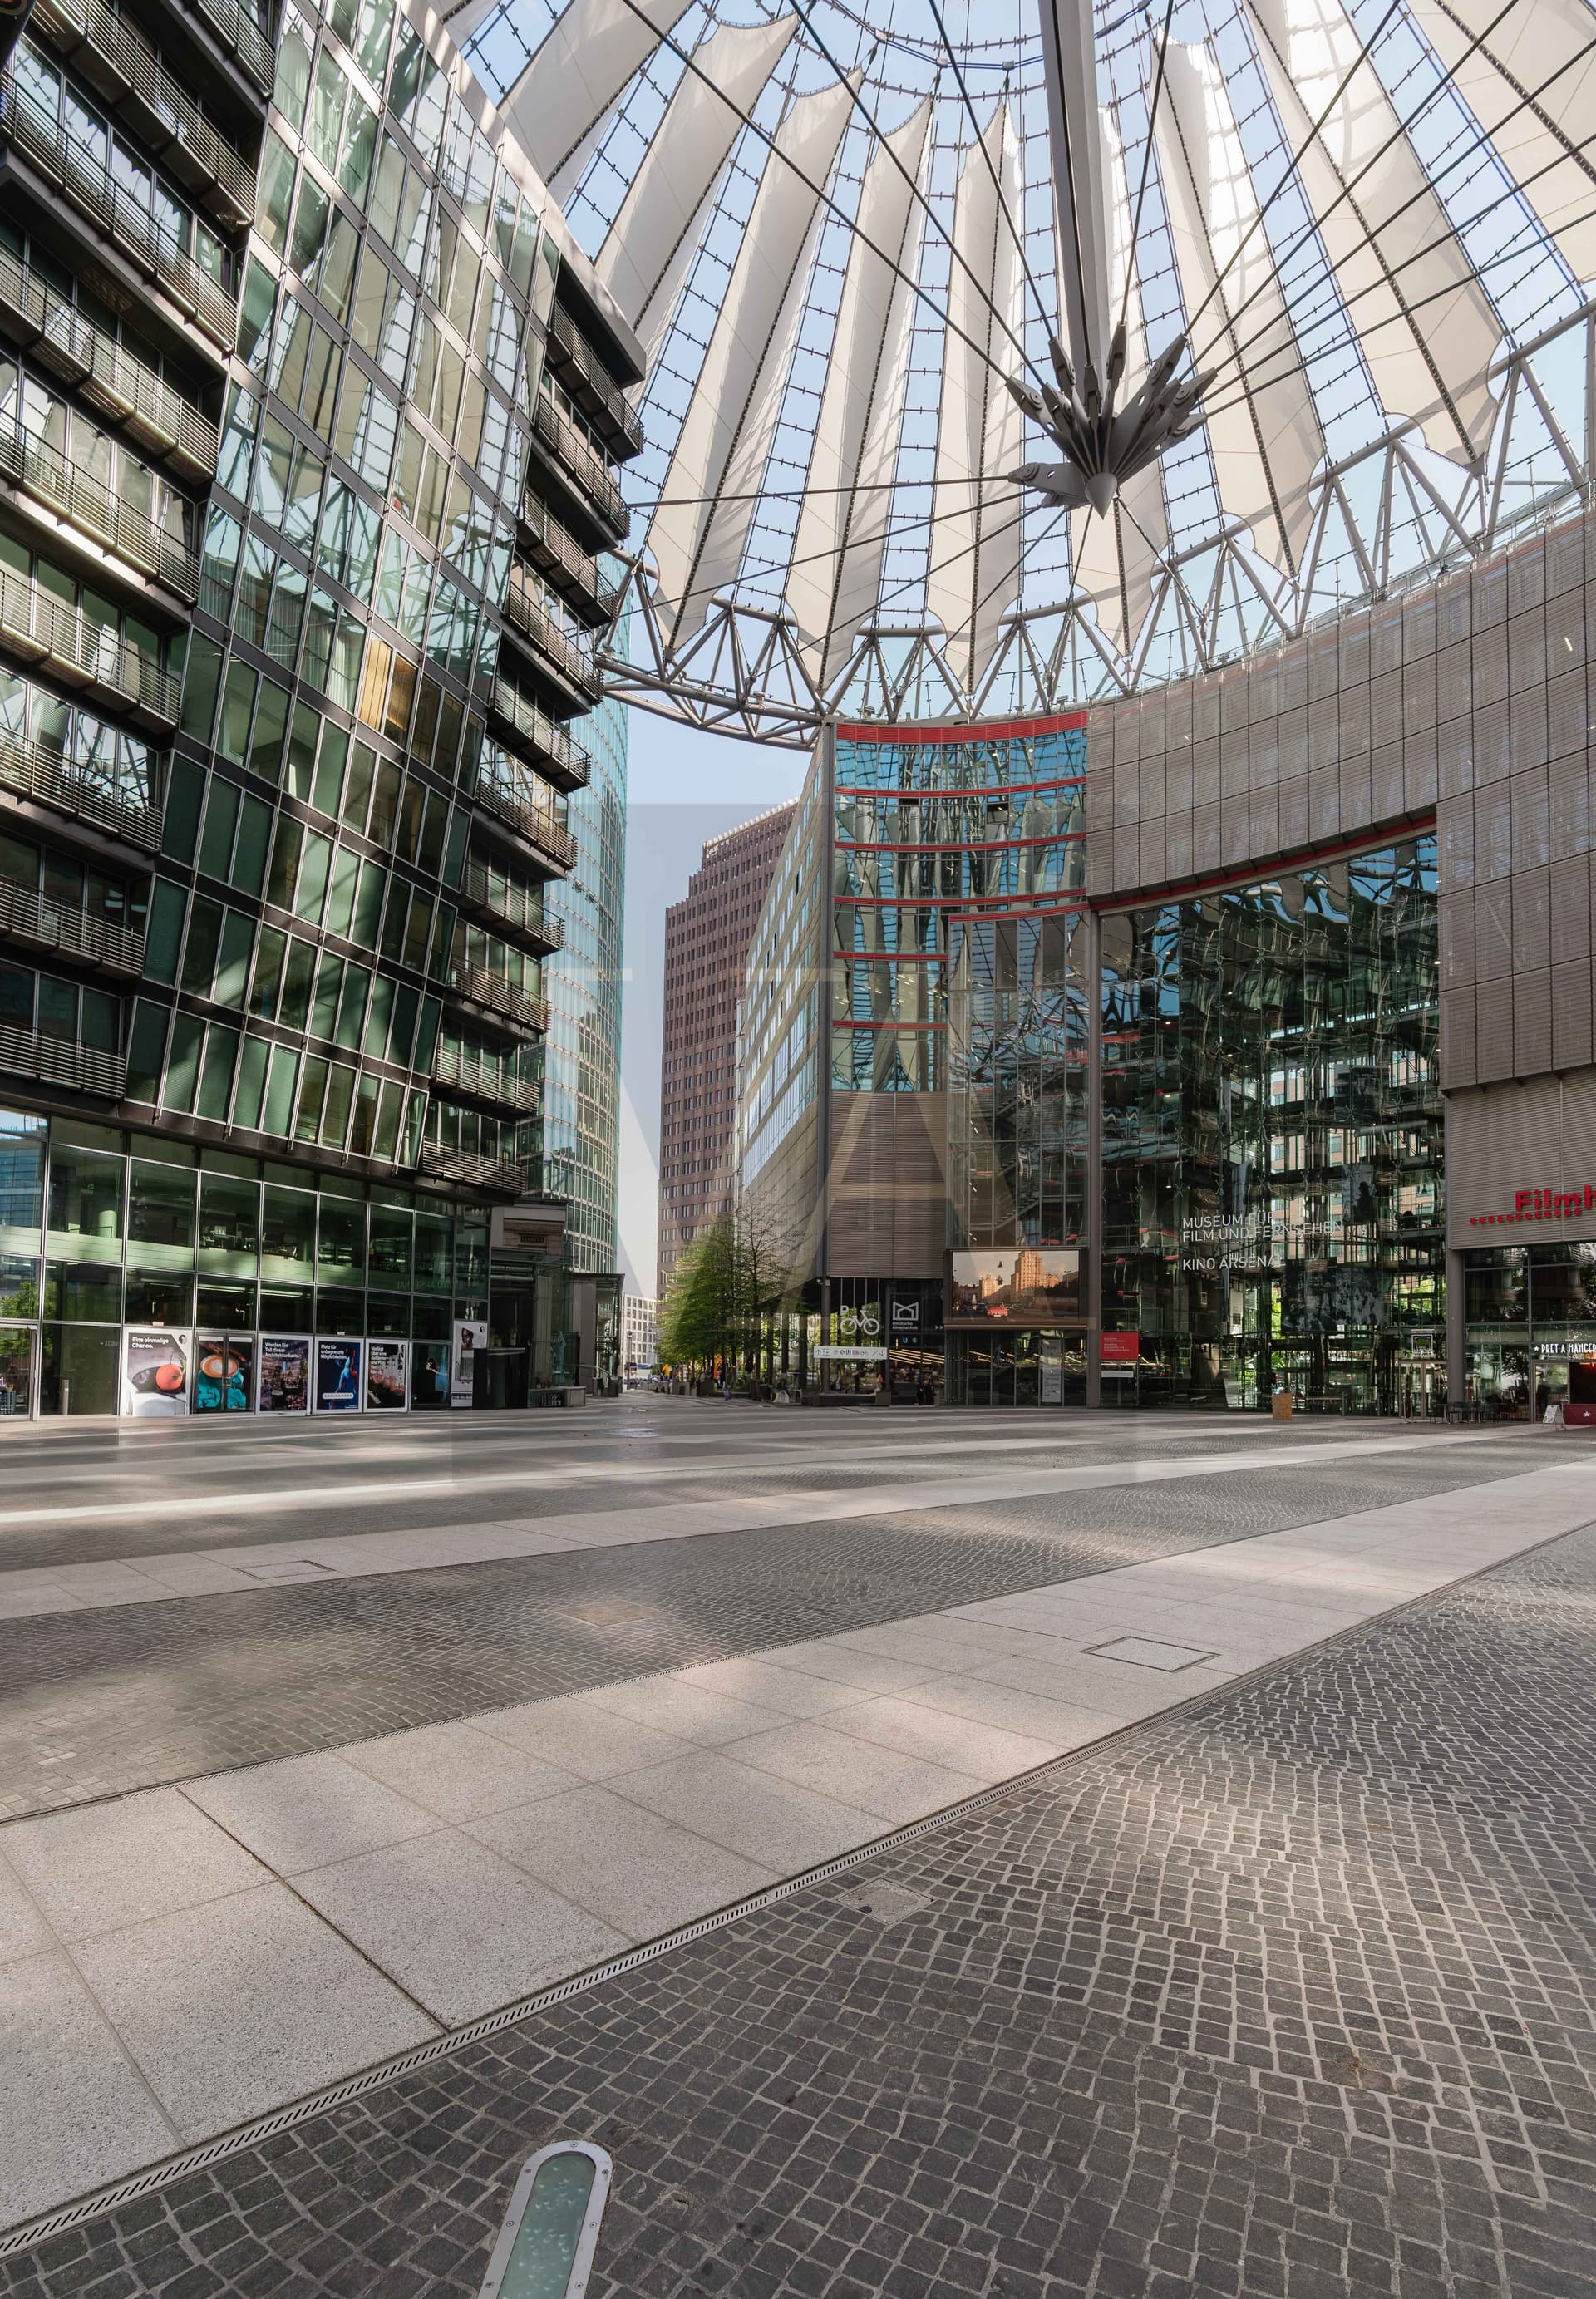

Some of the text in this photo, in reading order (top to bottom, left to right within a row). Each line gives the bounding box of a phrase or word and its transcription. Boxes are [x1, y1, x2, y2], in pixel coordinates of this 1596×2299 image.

[1182, 1214, 1243, 1229] MUSEUM
[1182, 1220, 1344, 1243] FILM UND FERNSEHEN
[1182, 1258, 1216, 1271] KINO
[840, 1305, 849, 1316] P
[1541, 1343, 1559, 1353] PRET
[1560, 1344, 1566, 1353] A
